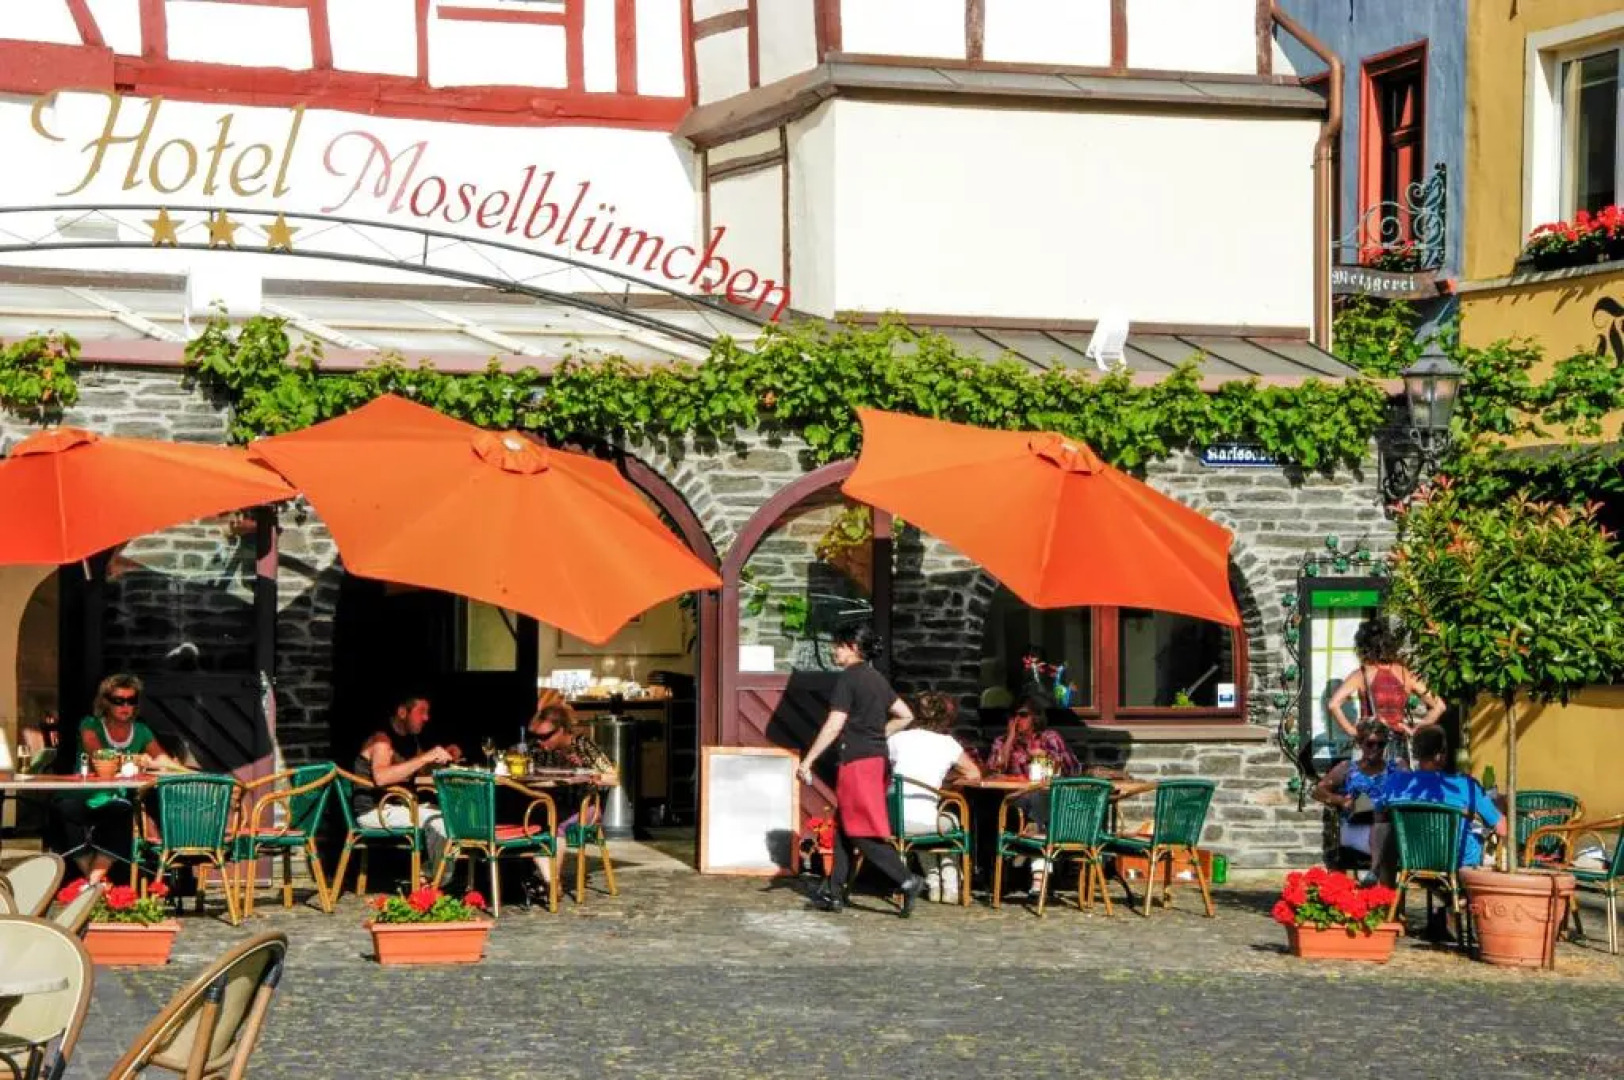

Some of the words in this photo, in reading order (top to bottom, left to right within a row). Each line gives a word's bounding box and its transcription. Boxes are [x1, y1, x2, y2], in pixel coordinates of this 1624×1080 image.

[31, 88, 306, 198] Hotel
[319, 129, 792, 322] Moselblümchen
[1331, 270, 1415, 292] Metzgerei
